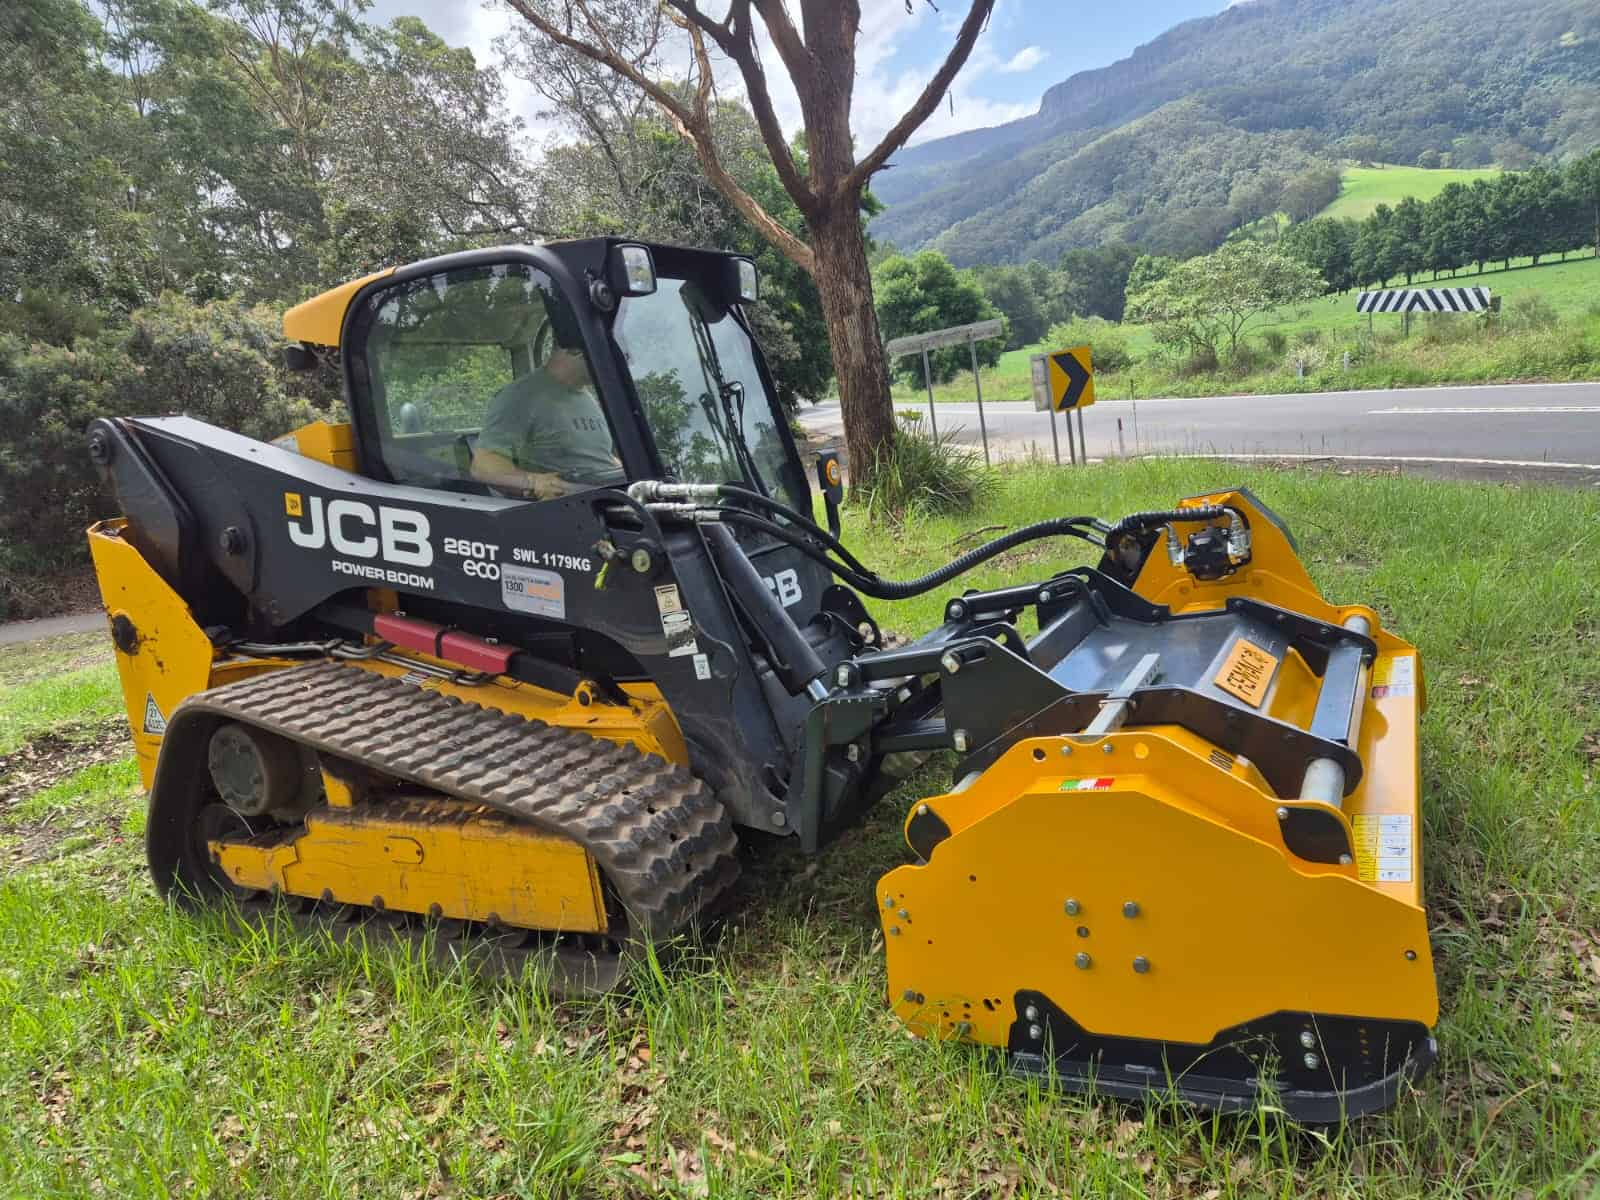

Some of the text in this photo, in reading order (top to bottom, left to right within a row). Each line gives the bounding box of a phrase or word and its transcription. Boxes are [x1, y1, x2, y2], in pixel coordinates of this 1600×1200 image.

[288, 496, 433, 567] JCB
[444, 538, 499, 560] 260T
[513, 548, 591, 571] SWL 1179KG
[332, 560, 434, 590] POWER BOOM
[463, 559, 499, 580] eco
